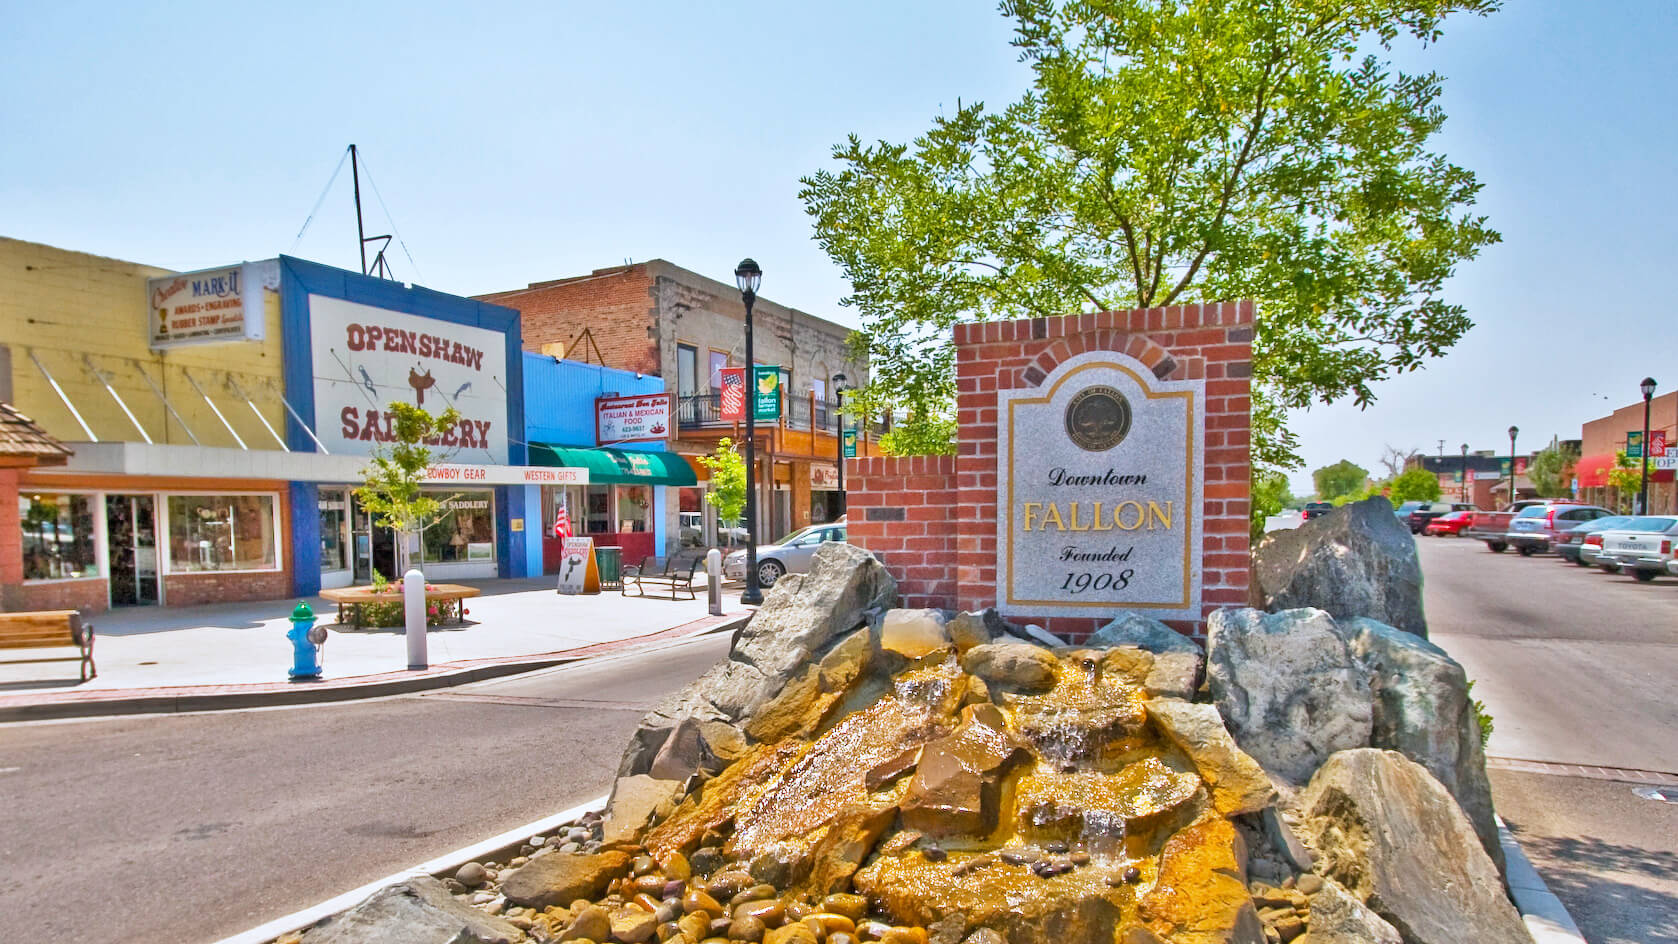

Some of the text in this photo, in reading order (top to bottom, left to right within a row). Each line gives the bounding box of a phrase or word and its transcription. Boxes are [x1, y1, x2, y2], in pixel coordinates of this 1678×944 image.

[171, 318, 196, 329] RUBBER
[198, 314, 220, 326] STAMP
[346, 323, 484, 371] OPENSHAW
[603, 412, 627, 420] ITALIAN
[635, 409, 664, 417] MEXICAN
[464, 468, 486, 480] GEAR
[524, 470, 577, 481] WESTERN GIFTS
[1048, 467, 1147, 487] Downtown
[449, 500, 489, 509] SADDLERY
[1023, 500, 1173, 532] FALLON
[1059, 545, 1134, 562] Founded
[1618, 542, 1647, 550] TOYOTA
[1060, 568, 1134, 594] 1908
